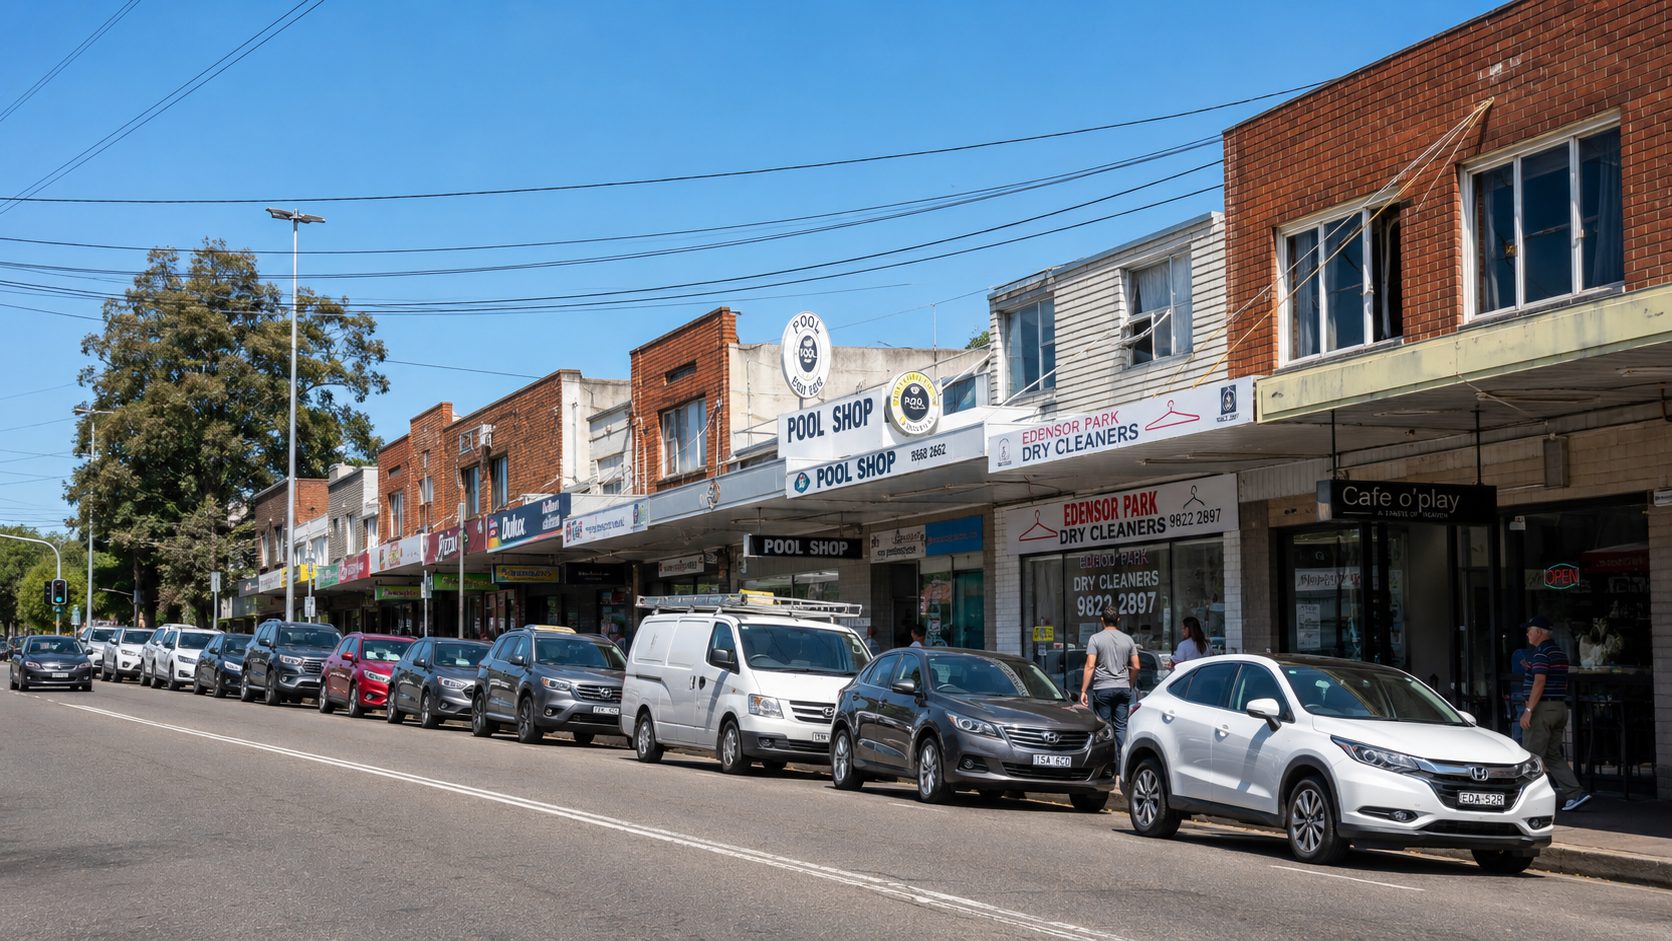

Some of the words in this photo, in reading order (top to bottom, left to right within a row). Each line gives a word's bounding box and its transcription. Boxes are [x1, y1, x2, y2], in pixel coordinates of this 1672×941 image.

[787, 411, 825, 443] POOL
[832, 398, 873, 433] SHOP
[1022, 421, 1080, 445] EDENSOR
[1084, 410, 1120, 430] PARK
[1022, 440, 1051, 462] DRY
[1055, 423, 1139, 455] CLEANERS
[816, 464, 853, 489] POOL
[857, 450, 897, 480] SHOP
[1063, 500, 1119, 526] EDENSOR
[1123, 490, 1158, 519] PARK
[1342, 486, 1392, 506] Cafe
[1399, 488, 1460, 514] o'play
[501, 514, 526, 541] Dulux
[1059, 526, 1086, 545] DRY
[1092, 516, 1166, 541] CLEANERS
[1169, 511, 1194, 528] 9822
[1196, 508, 1221, 525] 2897
[764, 538, 803, 555] POOL
[809, 539, 849, 556] SHOP
[1073, 575, 1096, 592] DRY
[1100, 570, 1160, 589] CLEANERS
[1544, 569, 1579, 585] OPEN
[1118, 591, 1157, 615] 2897
